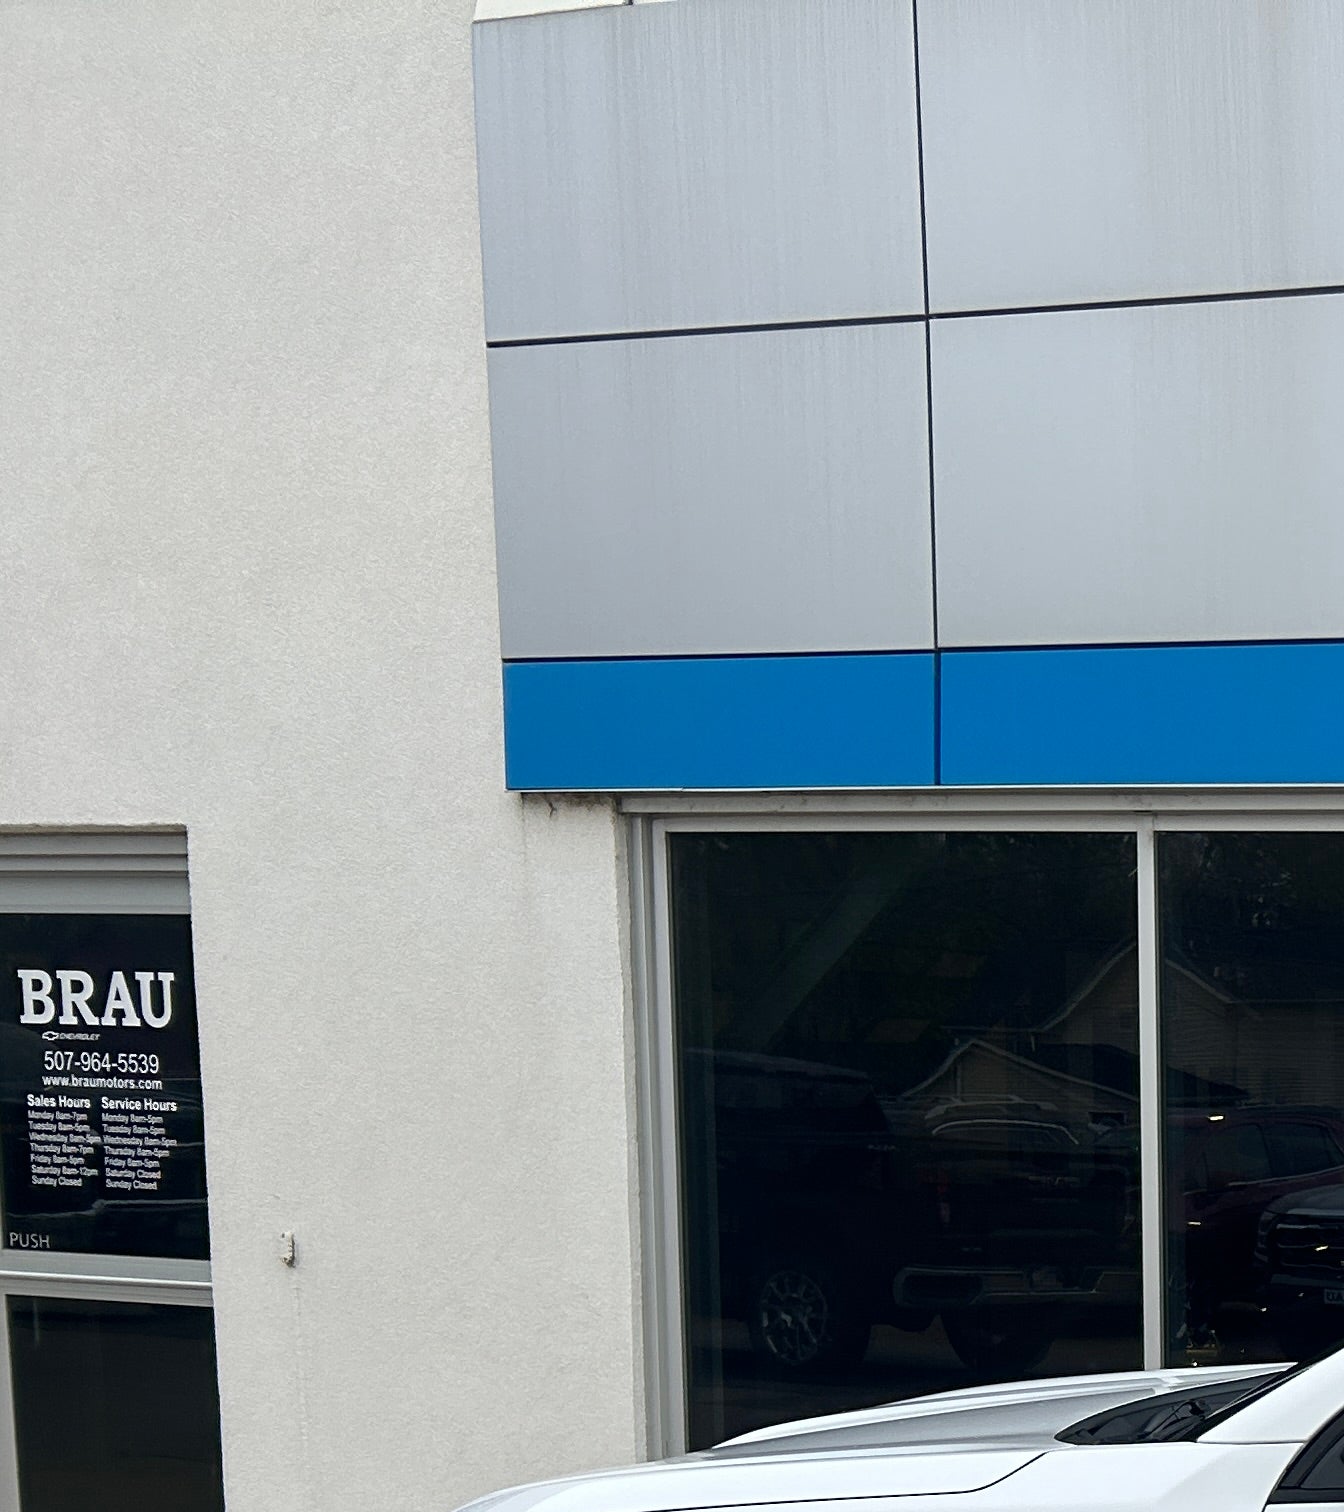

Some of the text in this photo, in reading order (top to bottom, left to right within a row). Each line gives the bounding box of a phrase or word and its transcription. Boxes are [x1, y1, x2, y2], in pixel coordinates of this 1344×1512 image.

[17, 969, 175, 1028] BRAU
[44, 1050, 159, 1074] 507-964-5539
[41, 1073, 163, 1090] www.braumotors.com
[27, 1094, 91, 1108] Sales Hours
[101, 1096, 177, 1111] Service Hours
[10, 1232, 50, 1248] PUSH
